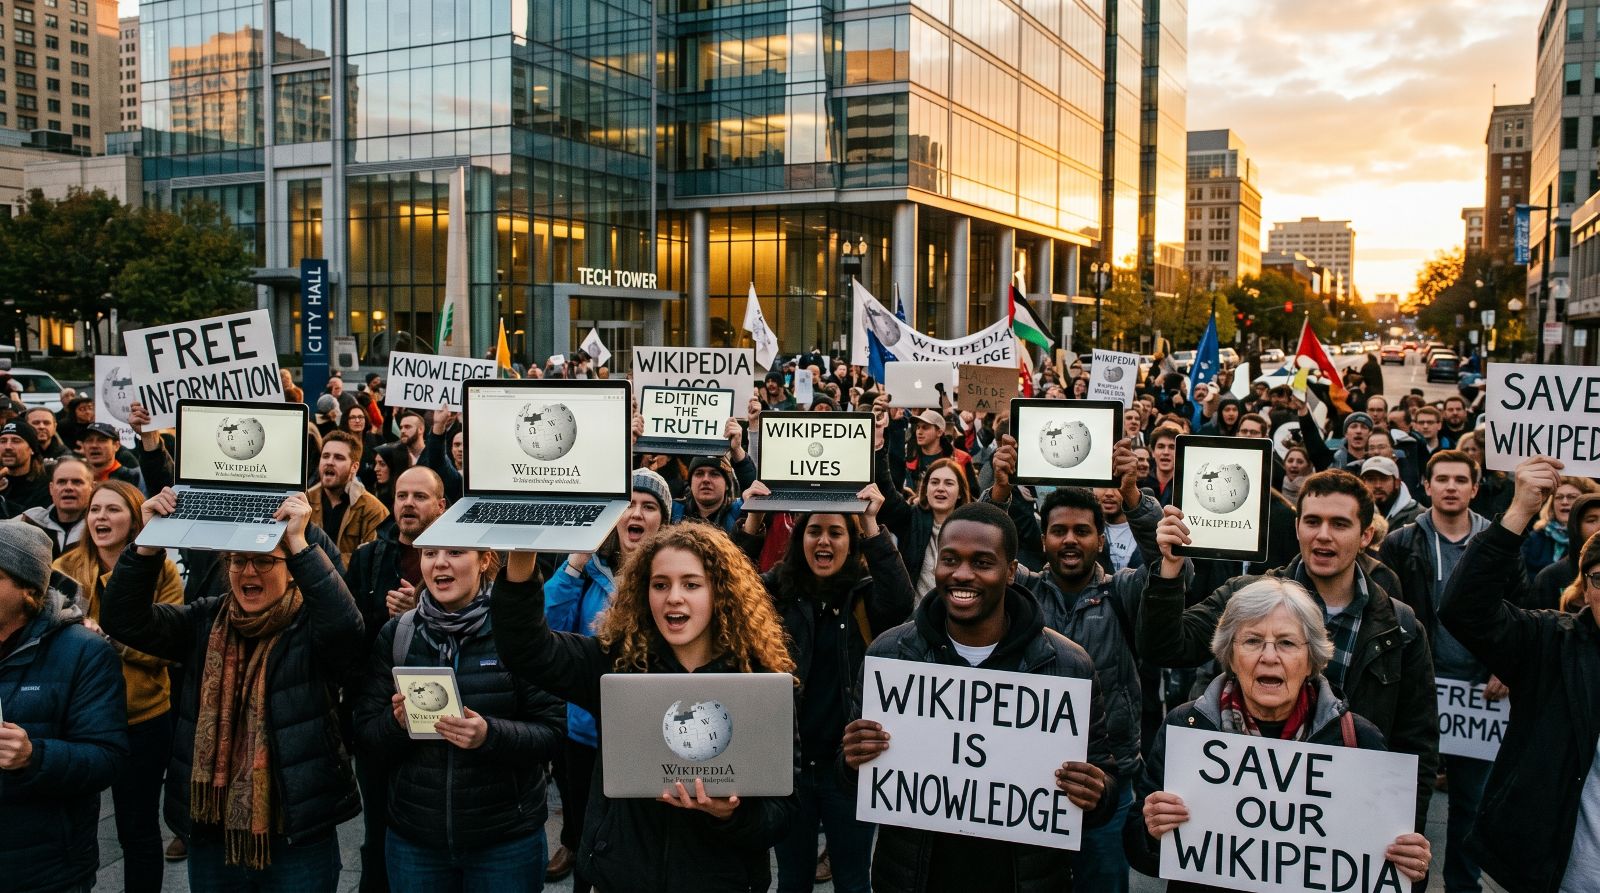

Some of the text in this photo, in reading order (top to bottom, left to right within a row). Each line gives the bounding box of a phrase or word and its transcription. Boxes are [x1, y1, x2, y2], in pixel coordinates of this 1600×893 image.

[577, 267, 657, 290] TECH TOWER
[308, 266, 322, 352] CITY HALL
[145, 317, 258, 374] FREE
[910, 328, 1013, 356] WIKIPEDIA
[391, 356, 494, 382] KNOWLEDGE
[636, 351, 751, 376] WIKIPEDIA
[1094, 353, 1136, 366] WIKIPEDIA
[139, 363, 281, 416] INFORMATION
[403, 383, 434, 404] FOR
[655, 392, 719, 406] EDITING
[1500, 373, 1600, 413] SAVE
[673, 406, 698, 417] THE
[651, 418, 718, 435] TRUTH
[765, 422, 867, 439] WIKIPEDIA
[1490, 421, 1600, 461] WIKIPED
[510, 463, 581, 477] WIKIPEDIA
[790, 460, 841, 476] LIVES
[1188, 515, 1253, 530] WIKIPEDIA
[874, 670, 1079, 737] WIKIPEDIA
[952, 732, 987, 768] IS
[661, 763, 735, 775] WIKIPEDIA
[1198, 739, 1333, 798] SAVE
[870, 766, 1070, 836] KNOWLEDGE
[1235, 796, 1327, 838] OUR
[1173, 826, 1403, 893] WIKIPEDIA
